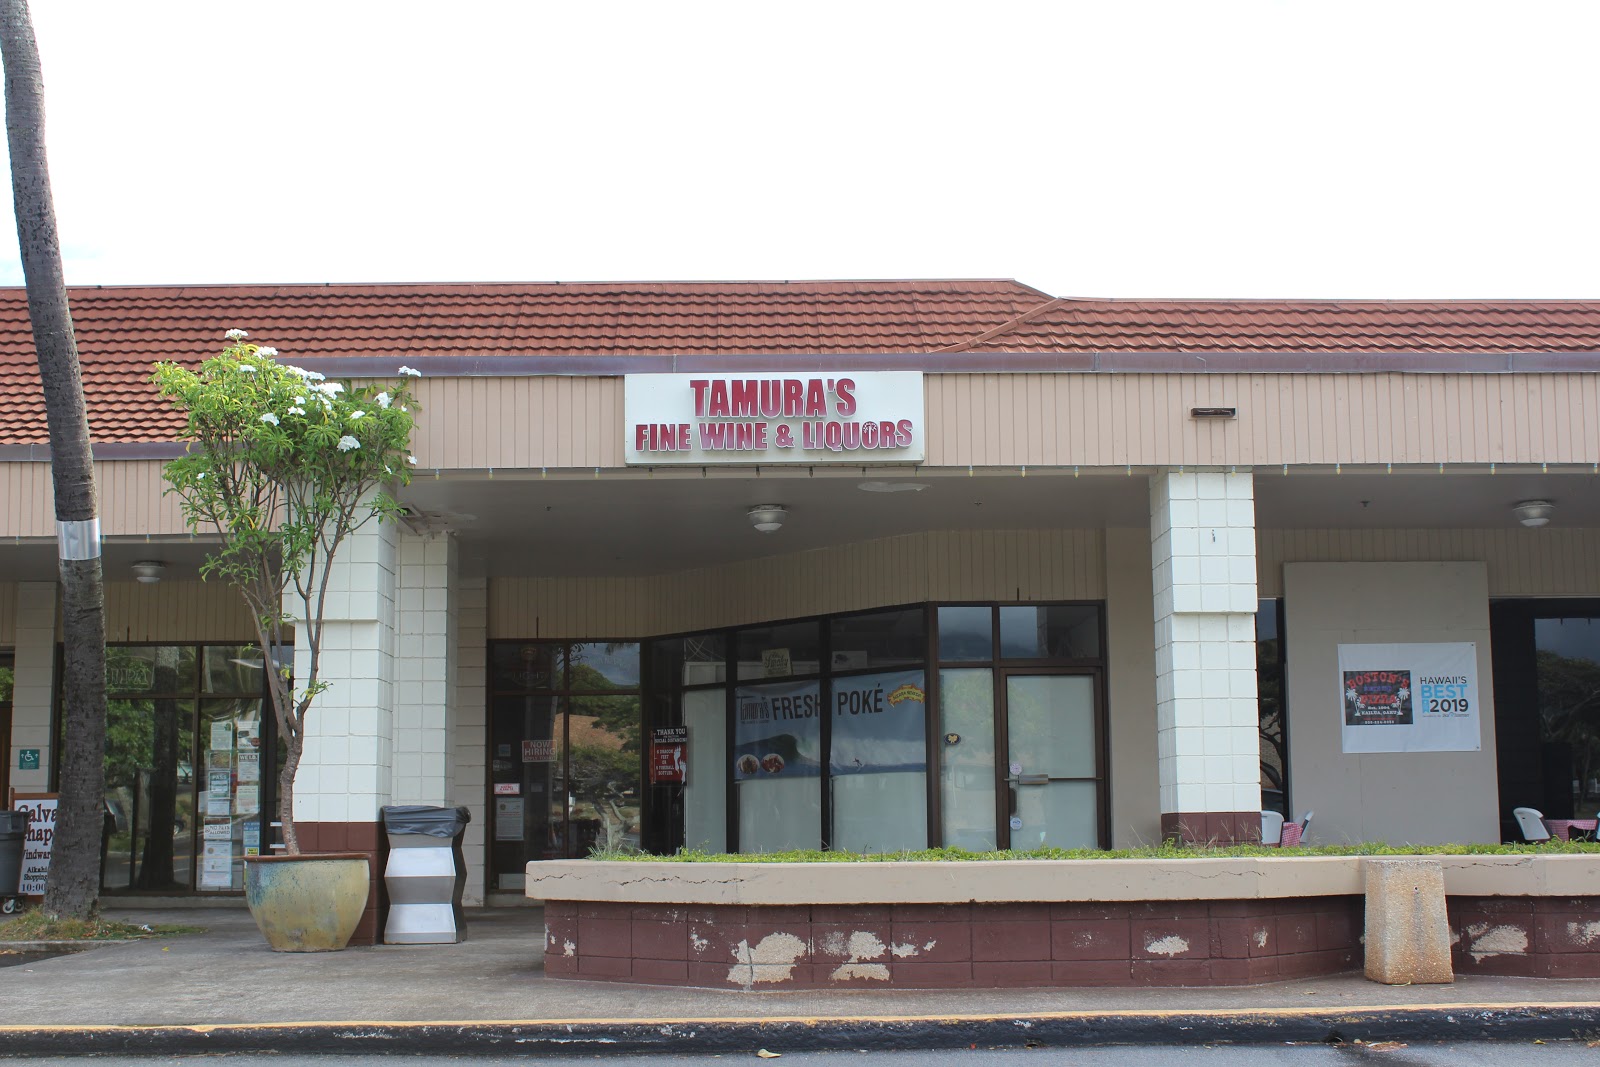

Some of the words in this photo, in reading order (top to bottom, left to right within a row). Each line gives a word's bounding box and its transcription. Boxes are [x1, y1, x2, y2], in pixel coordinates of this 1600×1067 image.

[690, 378, 857, 418] TAMURA'S
[635, 423, 693, 451] FINE
[699, 422, 768, 451] WINE
[775, 423, 795, 448] &
[803, 419, 913, 452] LIQUORS
[1420, 676, 1467, 685] HAWAII'S
[1421, 684, 1468, 699] BEST
[837, 683, 884, 716] POKÉ
[1360, 694, 1397, 704] PIZZA
[1430, 699, 1469, 713] 2019
[657, 728, 675, 736] THANK
[524, 748, 556, 756] HIRING
[25, 825, 53, 846] hap
